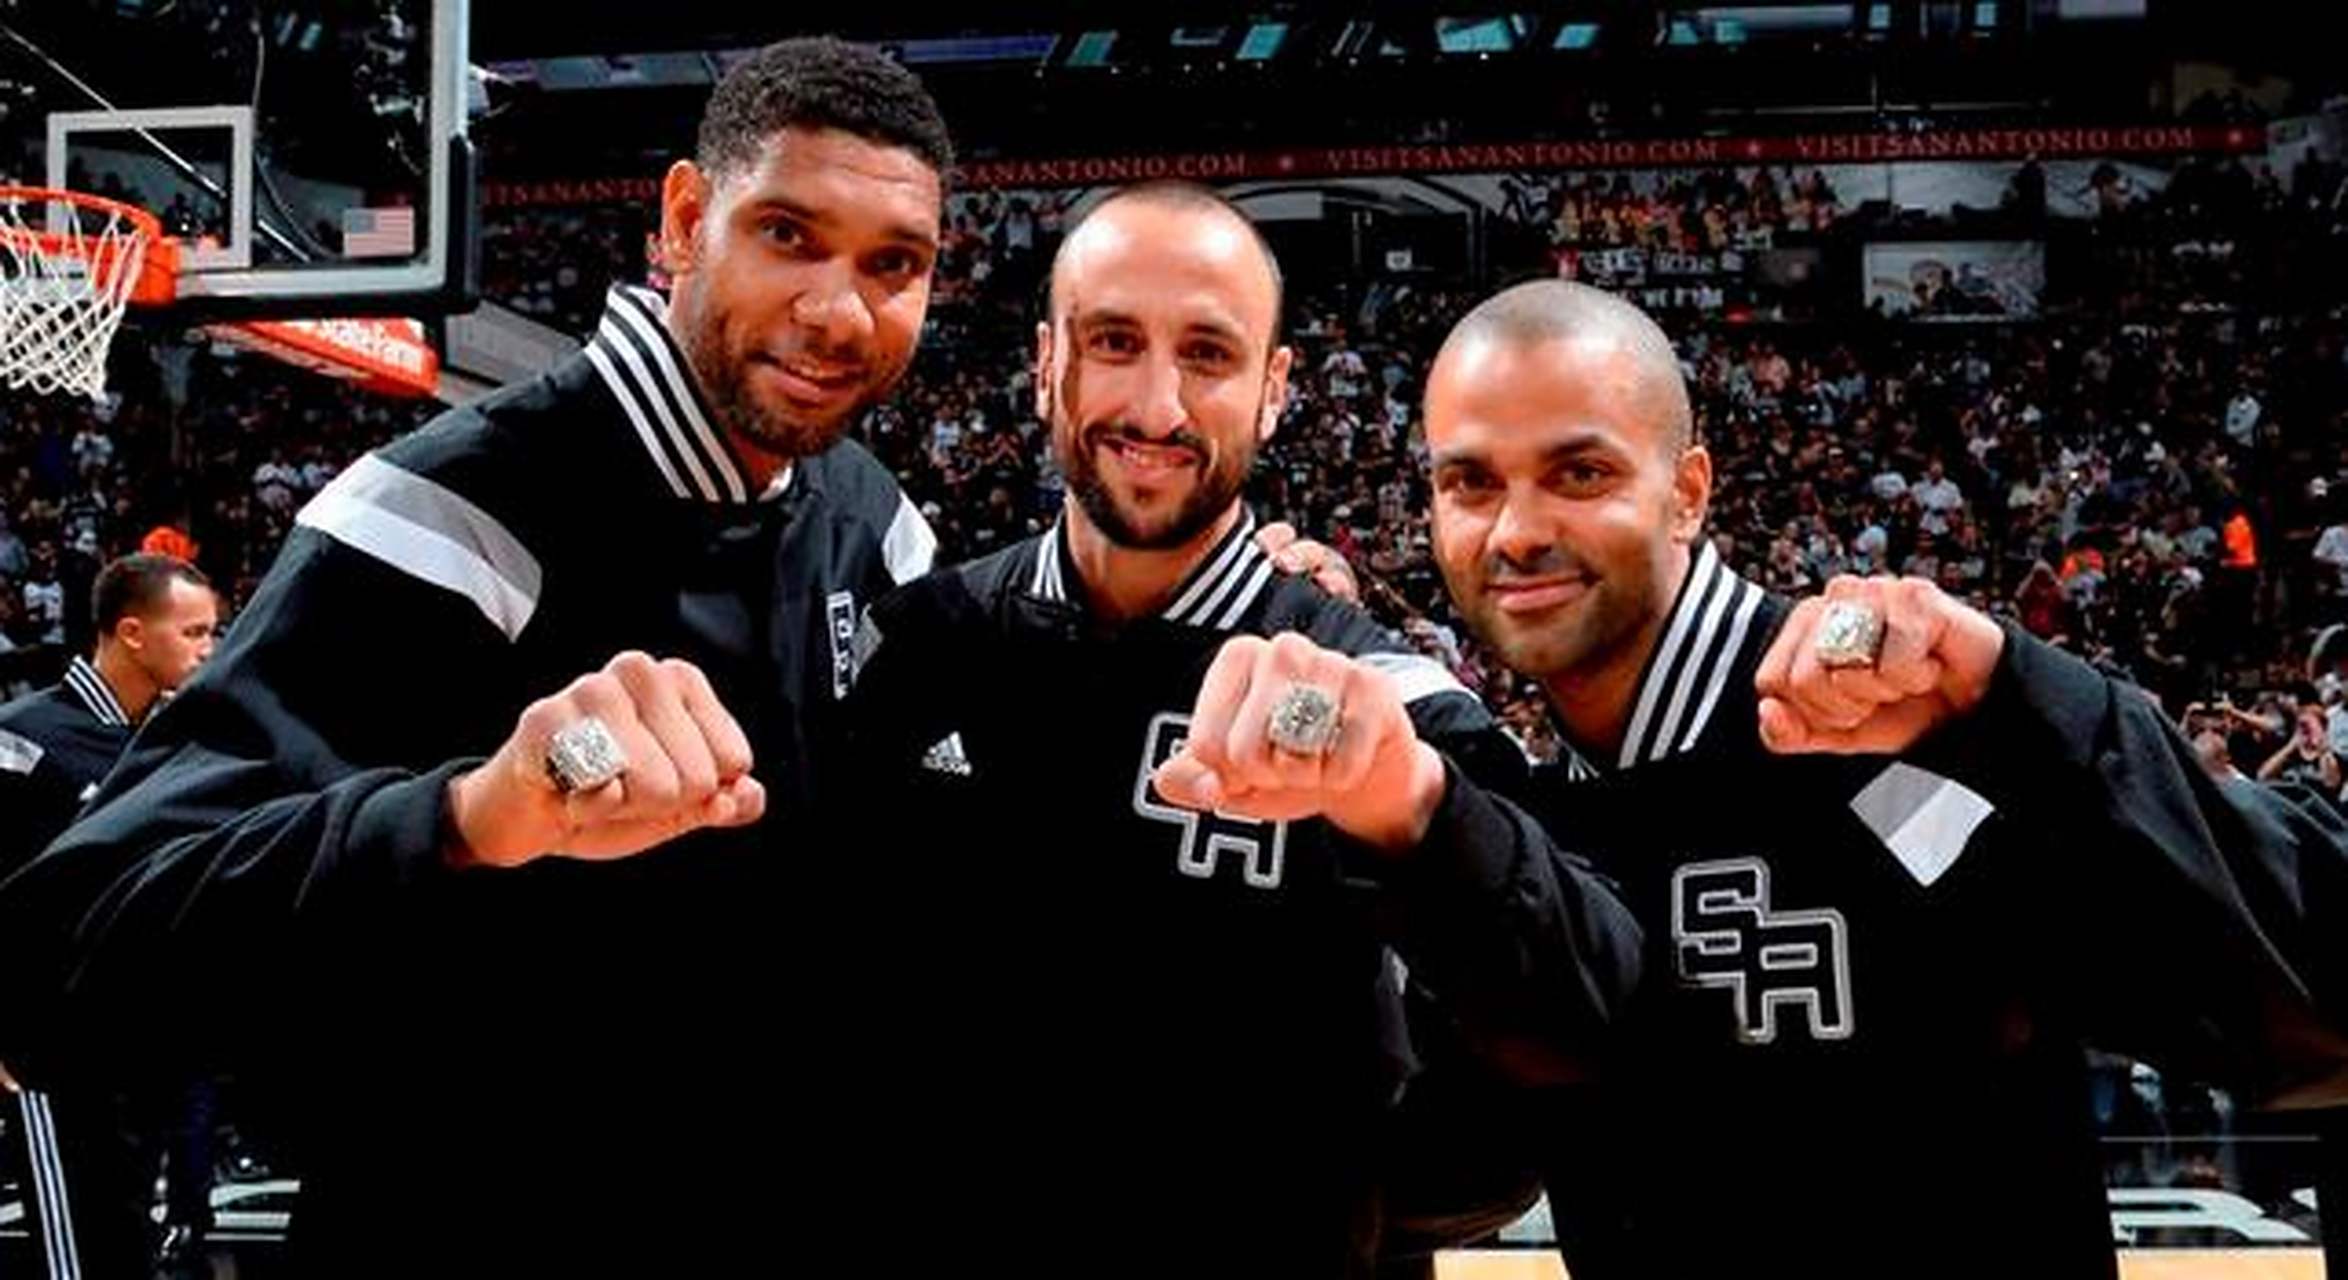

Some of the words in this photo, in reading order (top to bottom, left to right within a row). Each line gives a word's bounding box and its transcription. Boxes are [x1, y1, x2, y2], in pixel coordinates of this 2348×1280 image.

[1325, 141, 1717, 171] VISITSANANTONIO.COM
[1797, 129, 2193, 157] VISITSANANTONIO.COM
[951, 154, 1247, 184] SANANTONIO.COM
[1671, 857, 1854, 1044] SA
